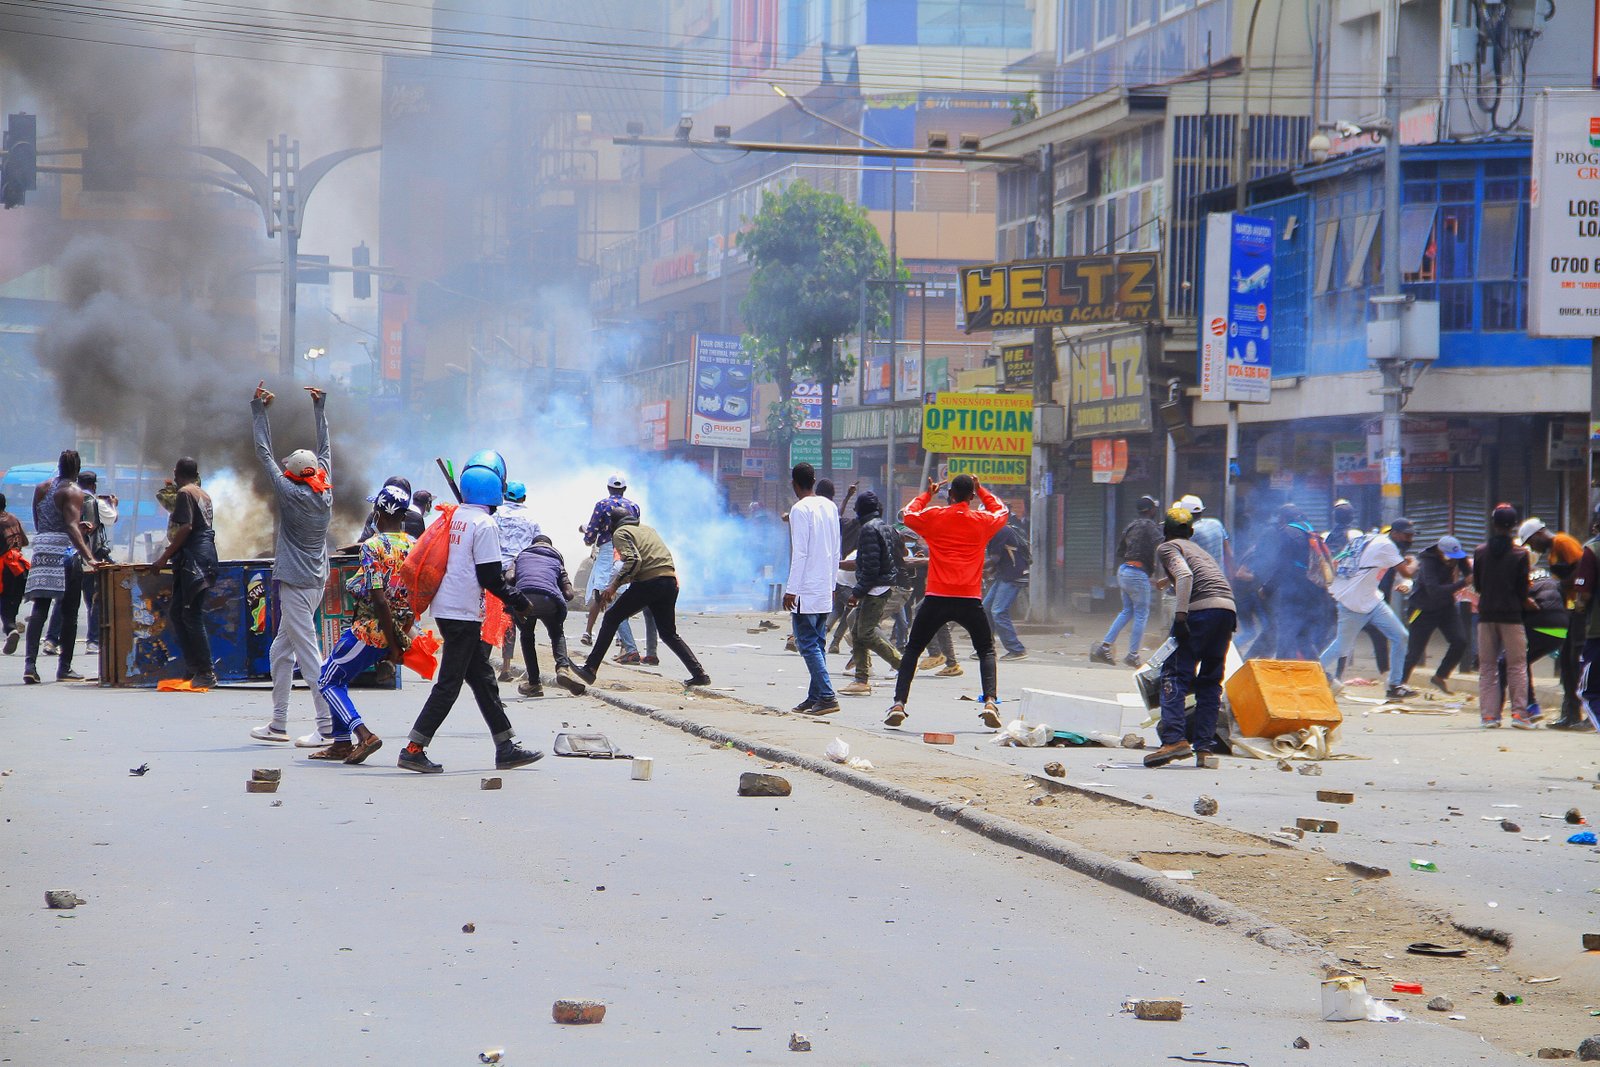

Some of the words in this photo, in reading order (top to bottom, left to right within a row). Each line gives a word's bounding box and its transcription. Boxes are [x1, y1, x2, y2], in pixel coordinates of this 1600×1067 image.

[1579, 221, 1600, 237] LO
[1551, 257, 1589, 273] 0700
[966, 260, 1155, 313] HELTZ
[991, 308, 1064, 326] DRIVING
[1559, 307, 1584, 317] QUICK,
[1004, 349, 1033, 362] HEL
[1072, 336, 1144, 405] HELTZ
[713, 424, 742, 433] RIKKO
[926, 408, 1033, 433] OPTICIAN
[952, 436, 1025, 452] MIWANI
[949, 459, 1025, 476] OPTICIANS
